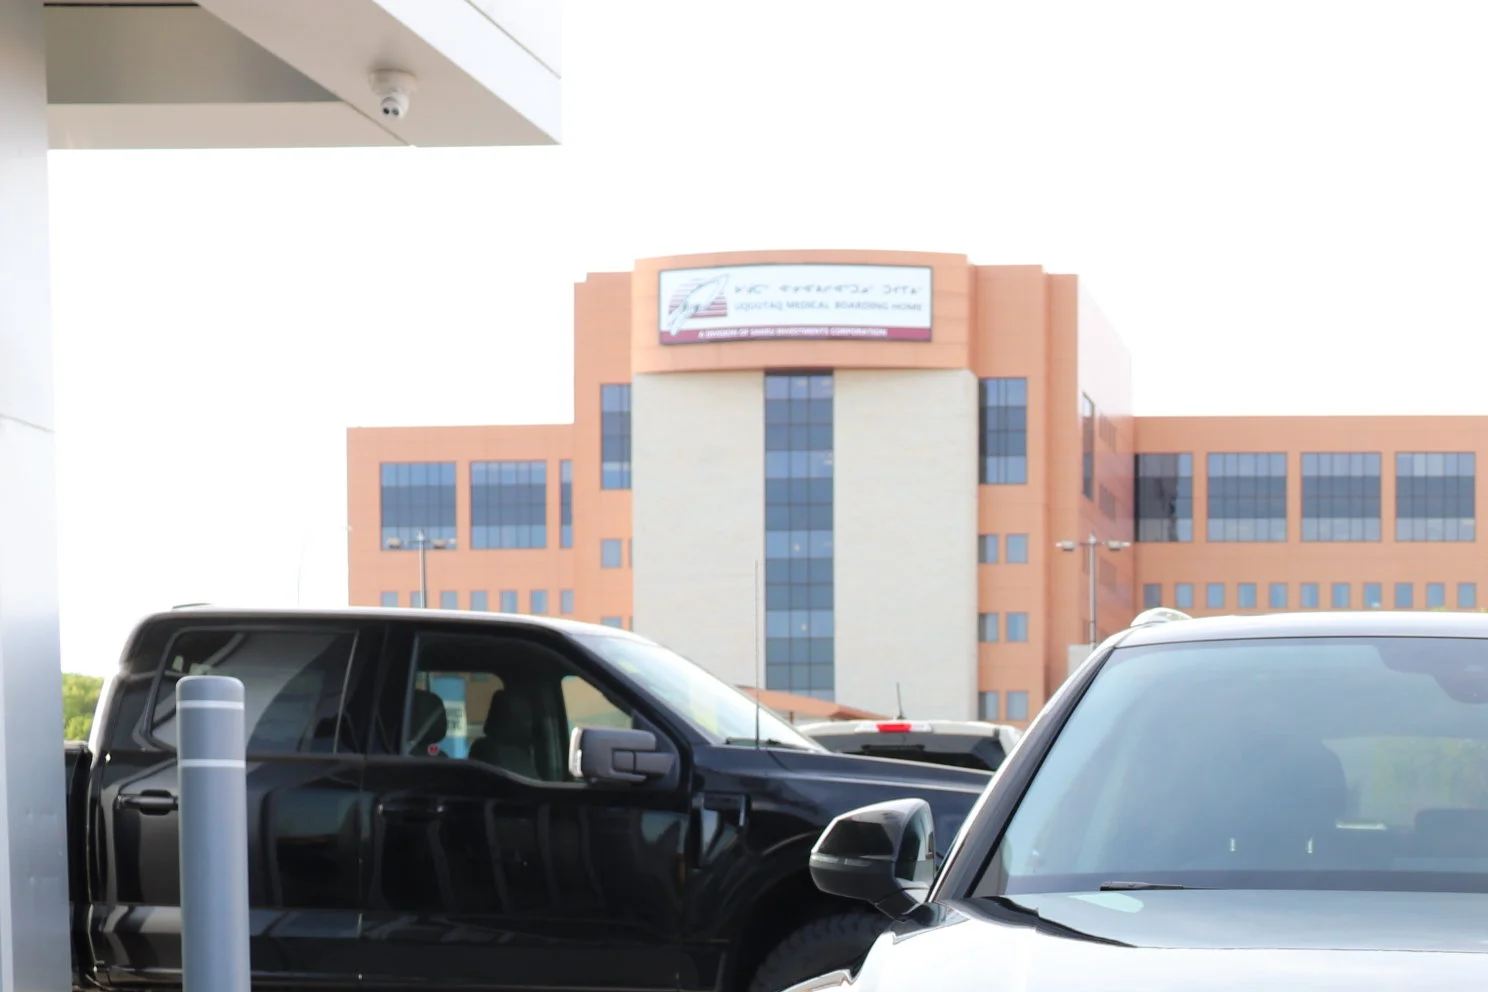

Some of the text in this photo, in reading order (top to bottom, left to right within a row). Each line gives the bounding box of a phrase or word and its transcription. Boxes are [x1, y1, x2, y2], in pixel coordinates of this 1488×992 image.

[786, 300, 830, 310] MEDICAL
[834, 300, 889, 310] BOARDING
[891, 302, 922, 312] HOME
